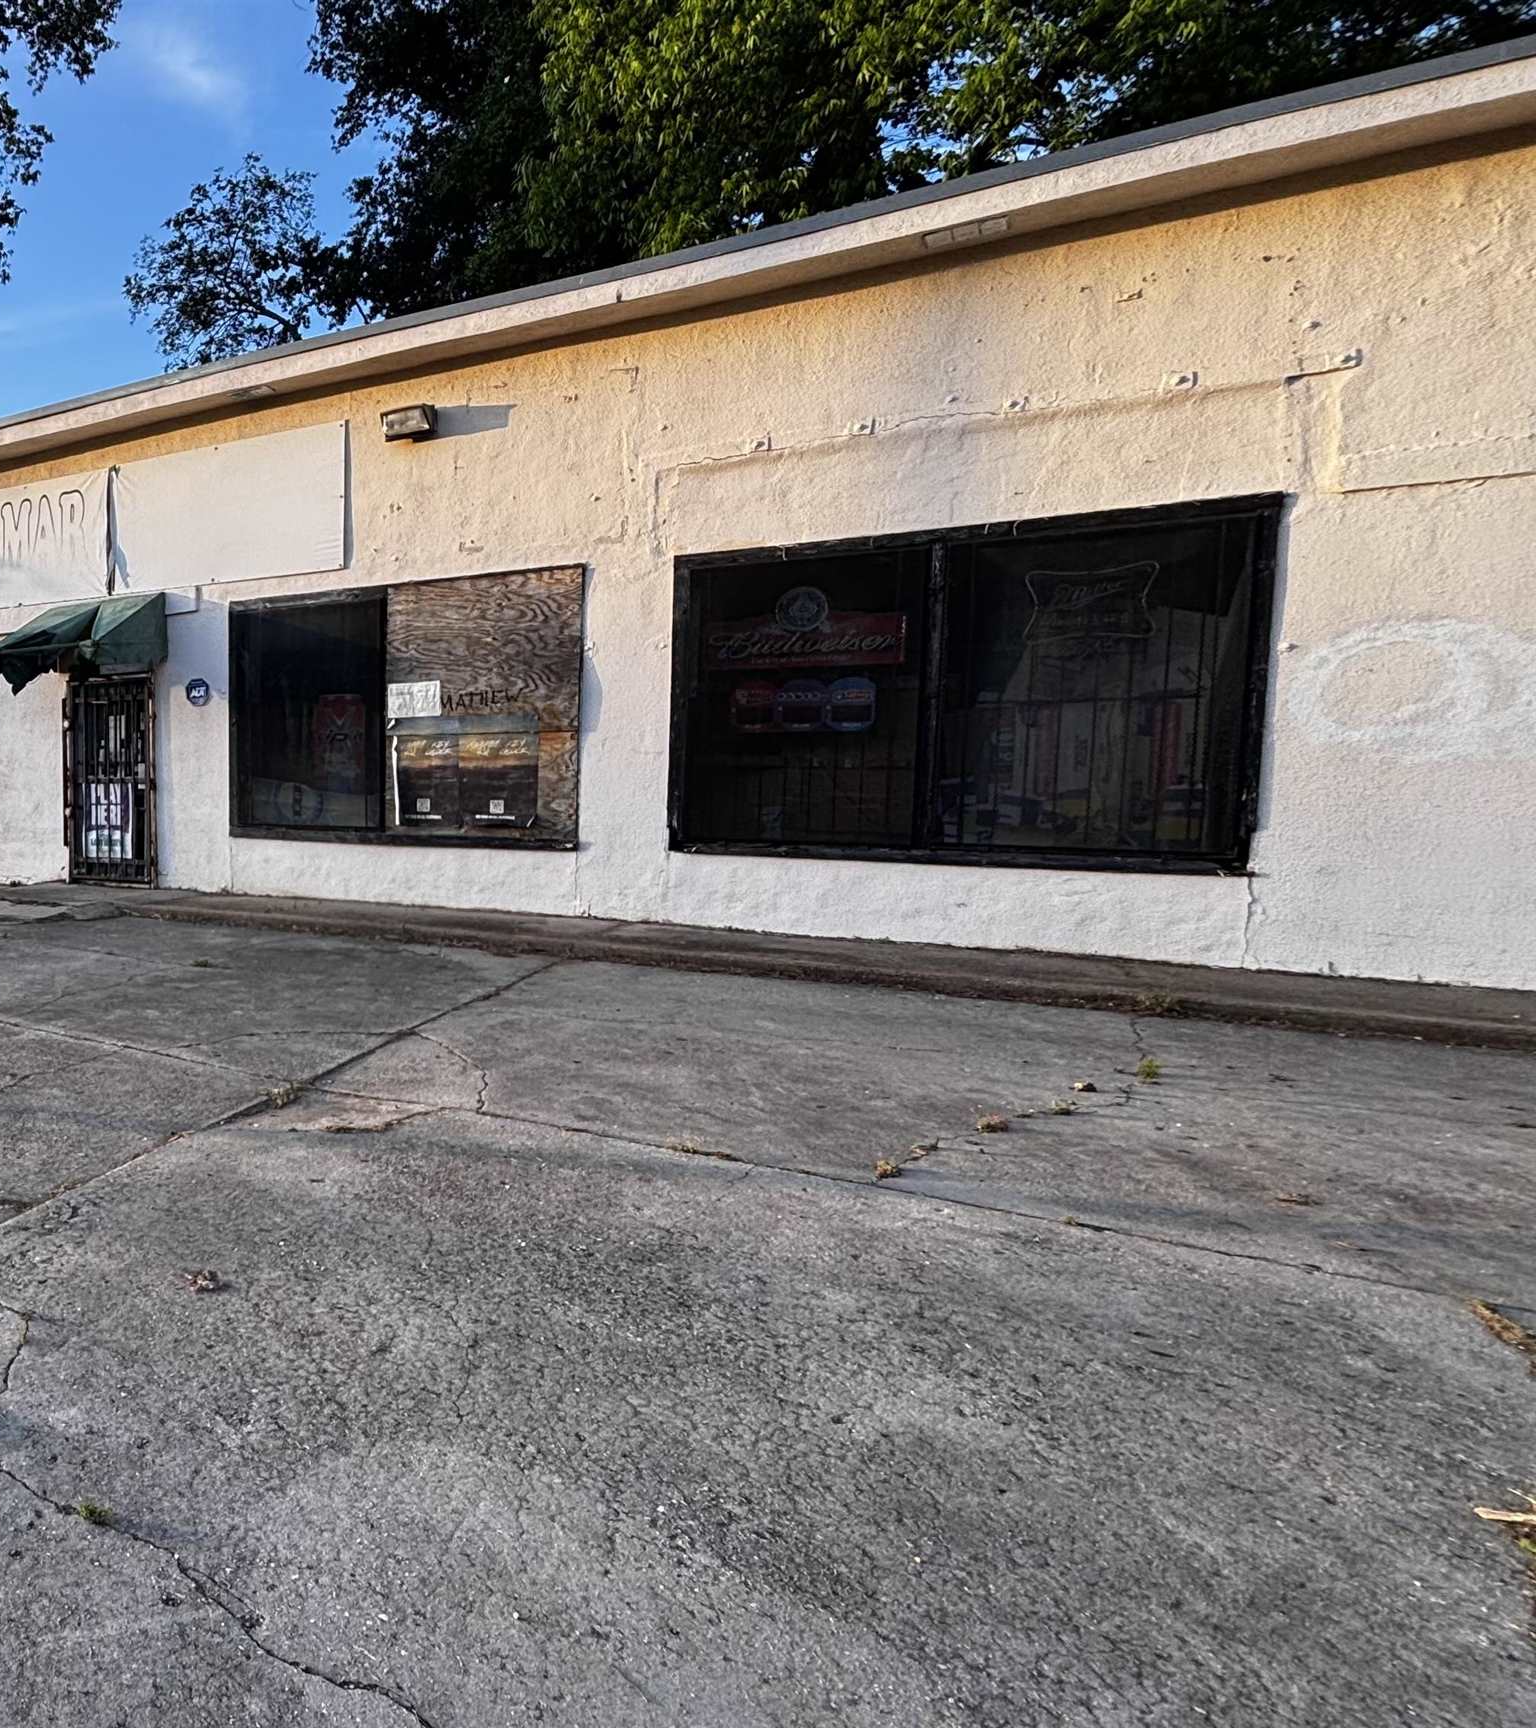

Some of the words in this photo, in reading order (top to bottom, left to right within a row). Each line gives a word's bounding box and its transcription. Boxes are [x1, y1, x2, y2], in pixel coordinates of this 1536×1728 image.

[709, 630, 895, 659] Budweiser
[190, 686, 207, 698] ADT
[90, 783, 121, 803] PLAY
